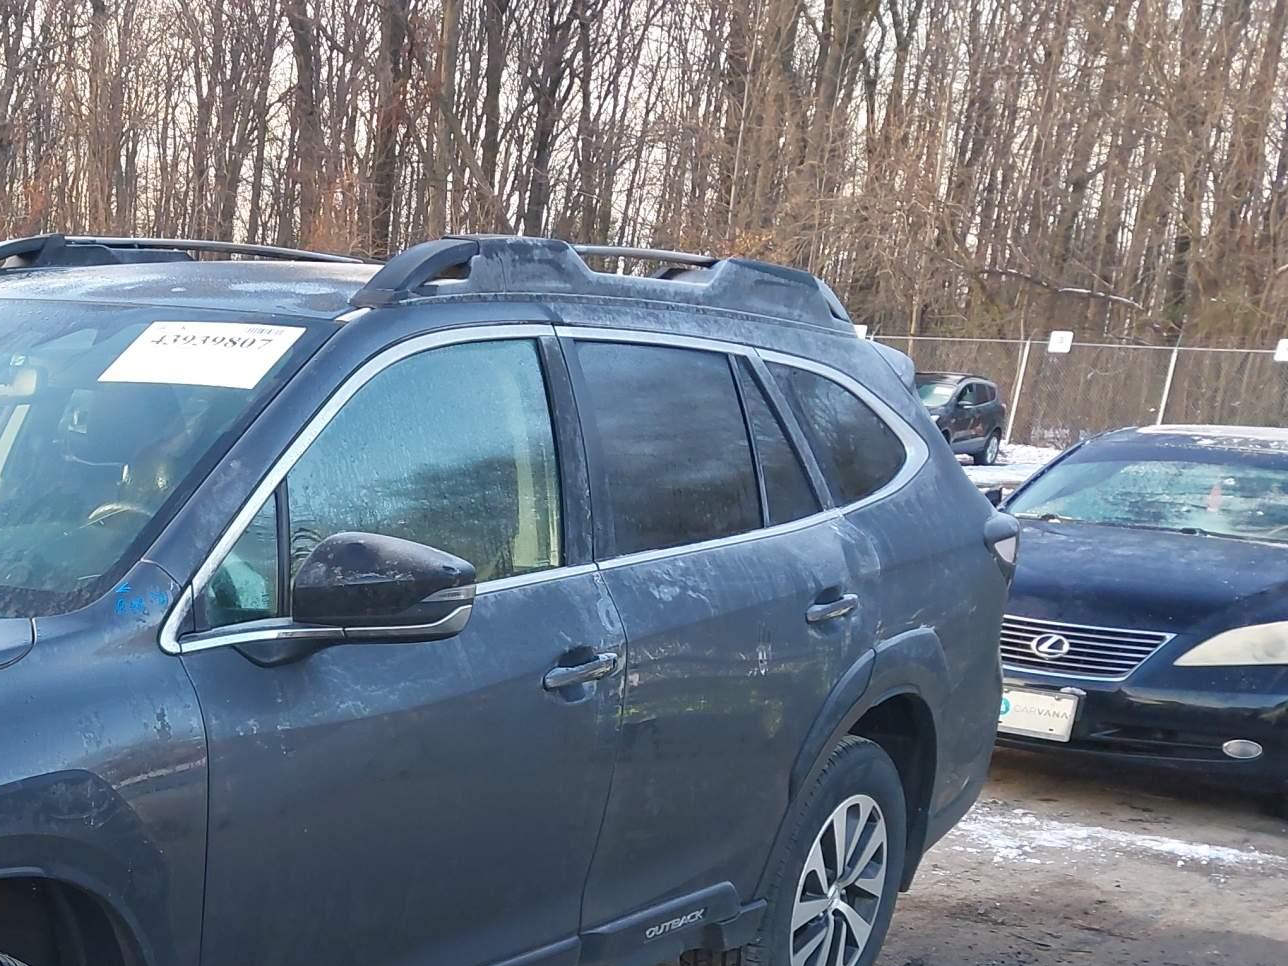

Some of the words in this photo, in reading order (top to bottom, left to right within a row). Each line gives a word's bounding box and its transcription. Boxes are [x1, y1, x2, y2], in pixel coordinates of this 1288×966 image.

[150, 334, 273, 350] 43939807
[1014, 704, 1069, 720] CARVANA
[645, 908, 705, 939] OUTBACK
